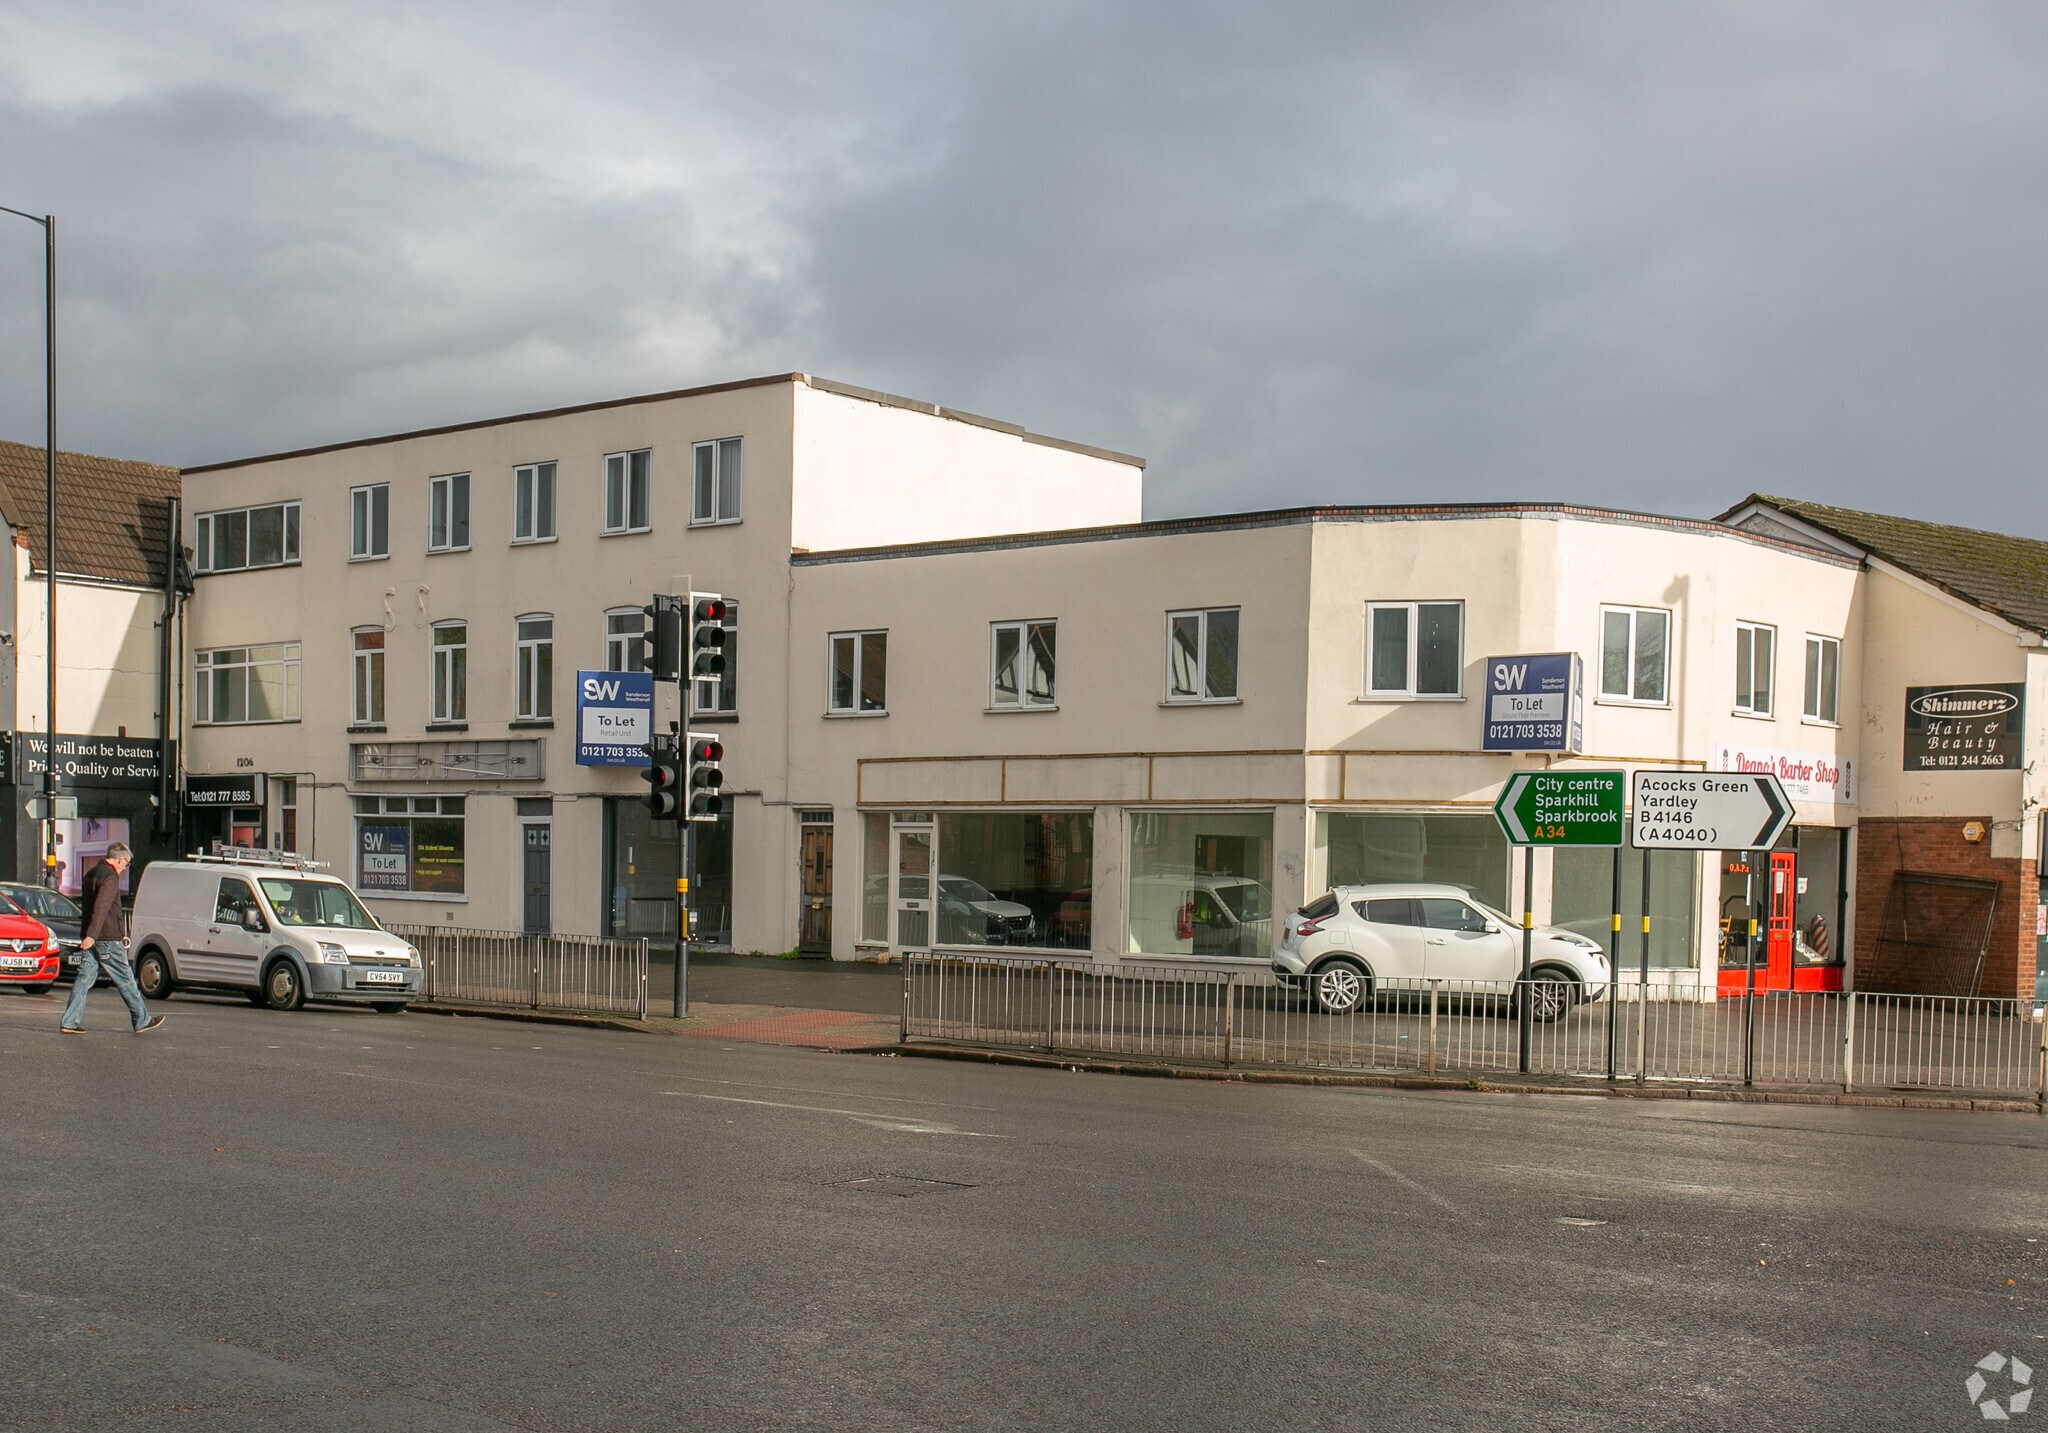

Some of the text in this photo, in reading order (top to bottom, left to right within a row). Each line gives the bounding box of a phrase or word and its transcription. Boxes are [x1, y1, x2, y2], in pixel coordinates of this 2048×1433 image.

[1494, 664, 1527, 690] SW
[583, 679, 620, 701] SW
[1511, 697, 1543, 711] To Let
[1921, 697, 2007, 713] Shimmerz
[597, 715, 635, 727] To Let
[1927, 721, 1999, 736] Hair &
[1490, 724, 1562, 738] 0121 703 3538
[29, 739, 48, 753] We
[78, 747, 97, 756] not
[100, 743, 113, 757] be
[117, 745, 153, 758] beaten
[582, 746, 604, 757] 0121
[606, 747, 624, 757] 703
[1927, 736, 1997, 753] Beauty
[236, 757, 254, 768] 1206
[1920, 755, 2004, 766] Tel: 0121 244 2663
[65, 761, 109, 778] Quality
[112, 766, 123, 776] or
[1779, 756, 1813, 781] Barber
[1815, 760, 1840, 790] Shop
[1535, 777, 1614, 793] City centre
[1640, 778, 1749, 793] Acocks Green
[218, 791, 231, 801] 777
[232, 790, 251, 801] 8585
[1535, 793, 1599, 808] Sparkhill
[1640, 794, 1698, 810] Yardley
[1535, 809, 1618, 824] Sparkbrook
[364, 832, 383, 852] SW
[372, 857, 397, 869] To Let
[363, 874, 407, 885] 0121 703 3538
[3, 958, 23, 966] NJ58
